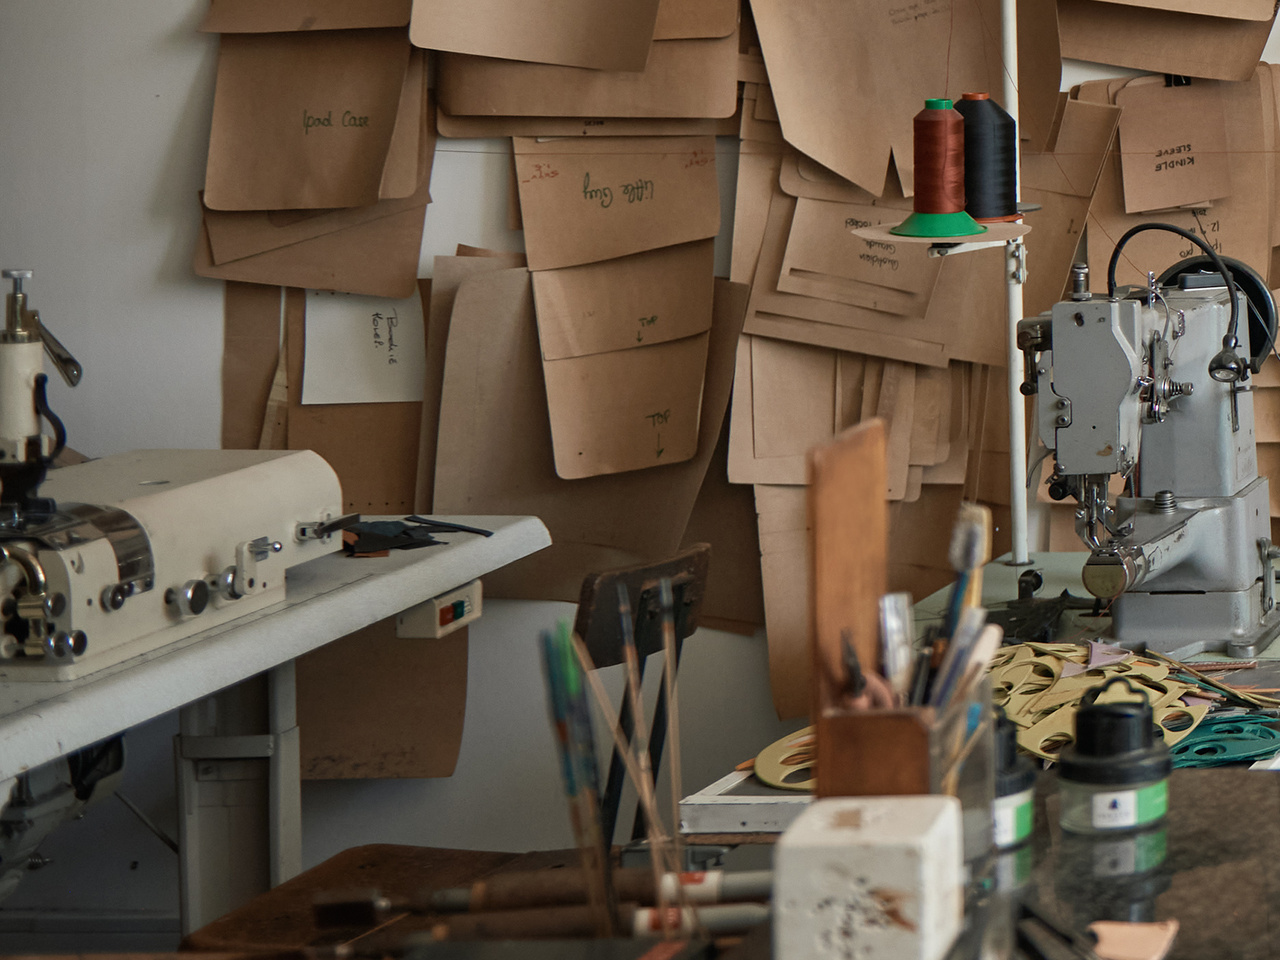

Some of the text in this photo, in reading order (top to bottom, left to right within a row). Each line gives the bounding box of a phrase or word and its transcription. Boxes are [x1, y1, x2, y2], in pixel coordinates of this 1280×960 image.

[341, 110, 369, 127] Case
[1155, 144, 1191, 157] SLEEVE
[1155, 156, 1195, 172] KINDLE
[583, 172, 614, 209] Guy
[638, 315, 658, 327] TOP
[645, 409, 670, 427] TOP
